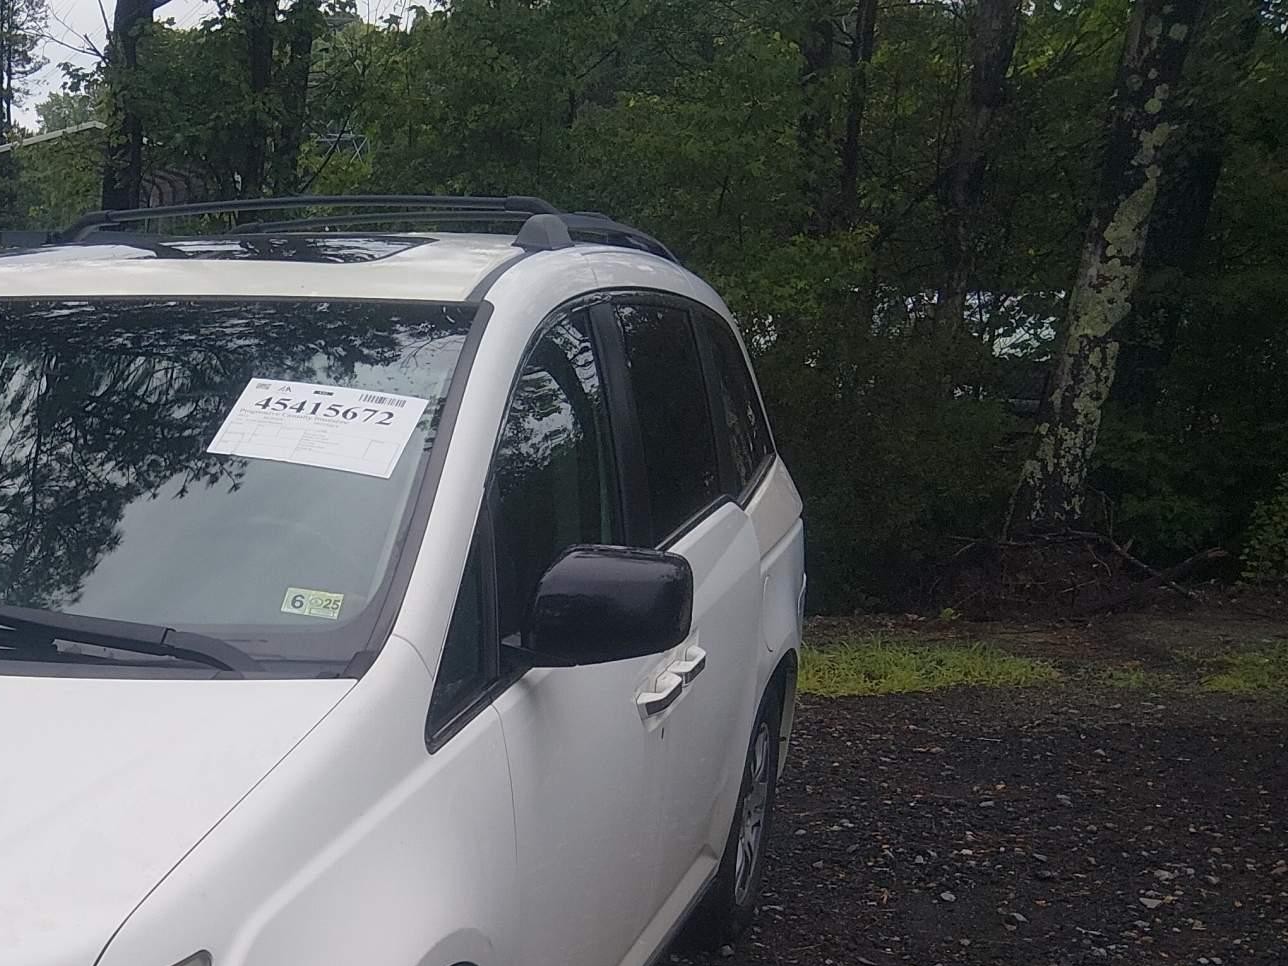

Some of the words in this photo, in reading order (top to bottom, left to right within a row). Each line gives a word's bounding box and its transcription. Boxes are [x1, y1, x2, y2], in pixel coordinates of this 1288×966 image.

[254, 396, 394, 426] 45415672
[291, 594, 305, 609] 6
[322, 598, 341, 610] 25
